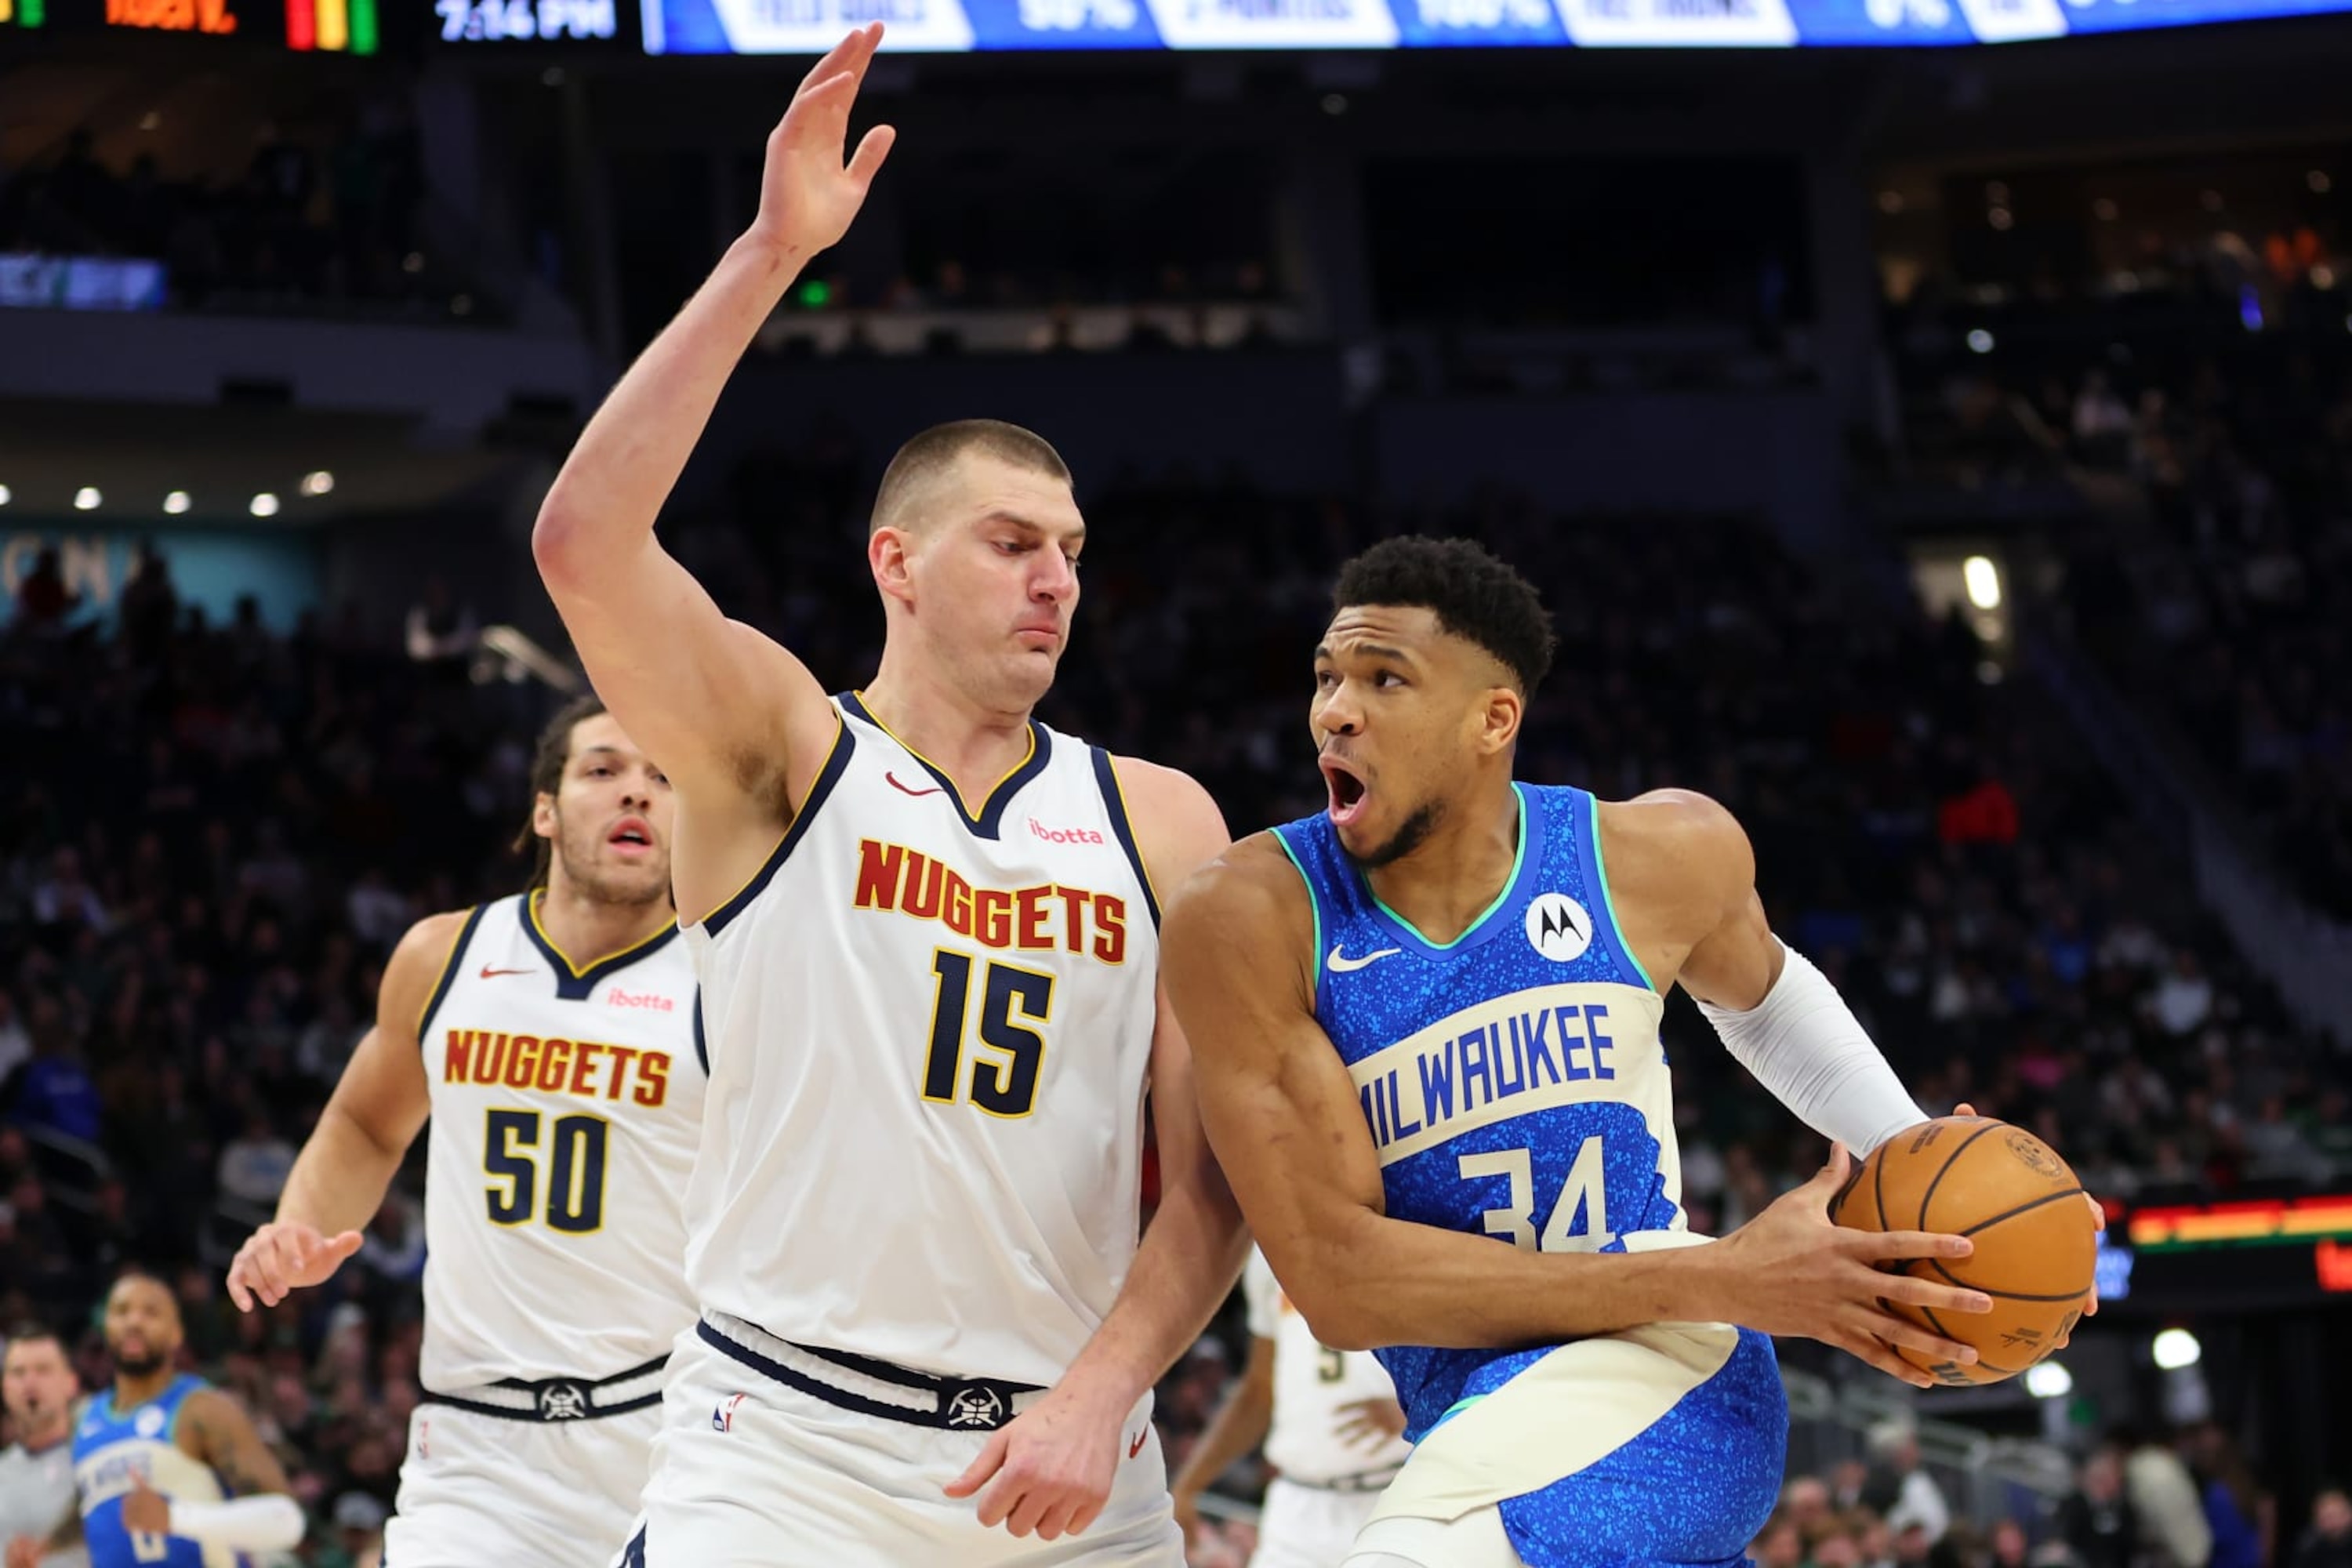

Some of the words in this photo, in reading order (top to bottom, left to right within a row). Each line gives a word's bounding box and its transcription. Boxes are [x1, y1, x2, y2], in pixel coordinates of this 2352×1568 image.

[537, 0, 617, 41] PM
[1028, 818, 1104, 844] ibotta
[853, 837, 1127, 966] NUGGETS
[608, 986, 675, 1013] ibotta
[920, 946, 1057, 1119] 15
[443, 1029, 672, 1109] NUGGETS
[482, 1106, 609, 1236] 50
[1458, 1135, 1617, 1254] 34
